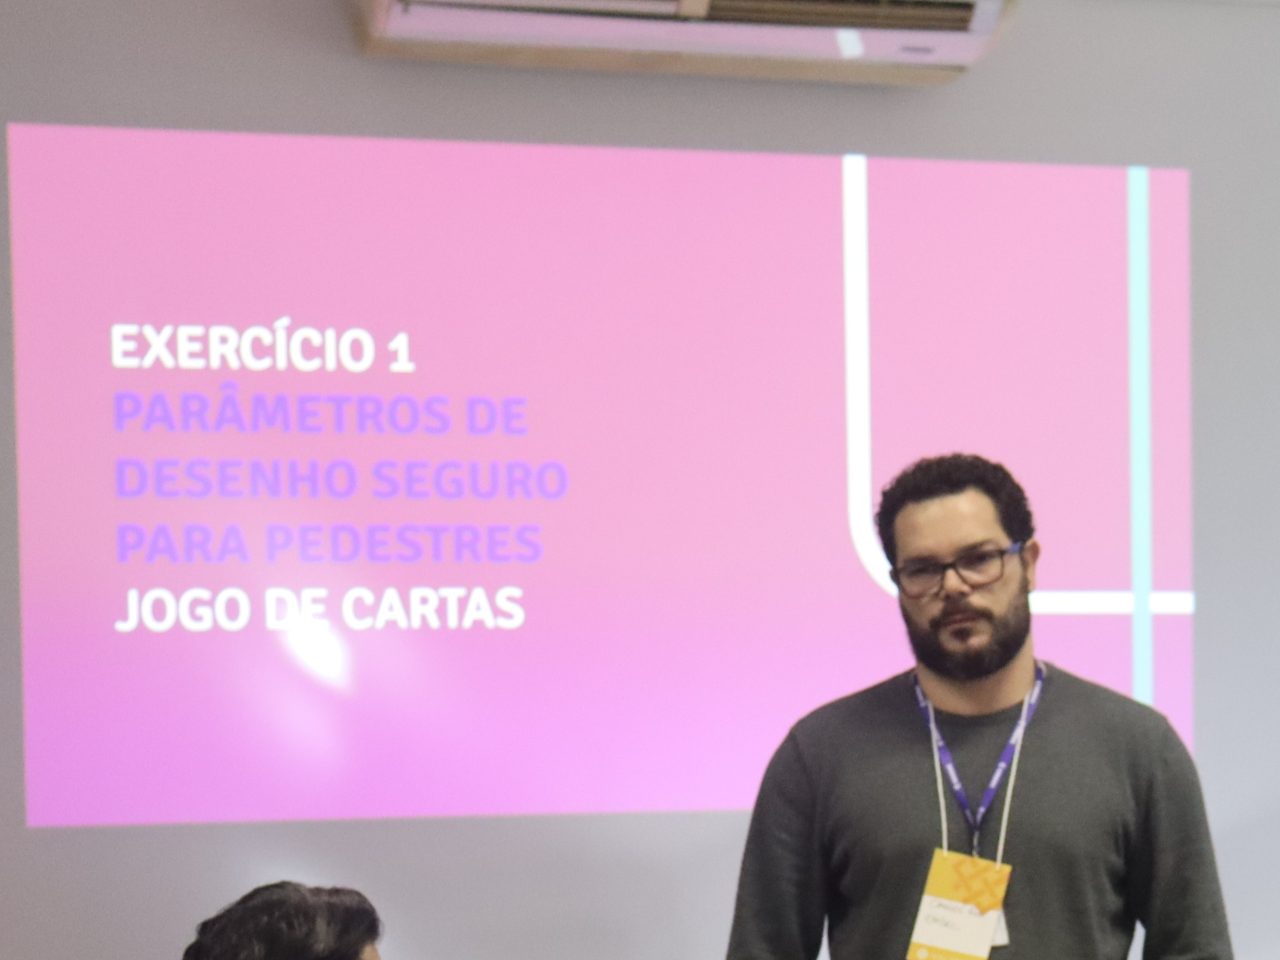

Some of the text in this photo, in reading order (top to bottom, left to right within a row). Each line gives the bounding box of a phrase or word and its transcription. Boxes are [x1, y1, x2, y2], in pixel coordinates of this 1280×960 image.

[111, 316, 416, 373] EXERCÍCIO 1
[113, 379, 529, 436] PARÂMETROS DE
[115, 457, 569, 501] DESENHO SEGURO
[116, 523, 544, 565] PARA PEDESTRES
[114, 586, 526, 632] JOGO DE CARTAS
